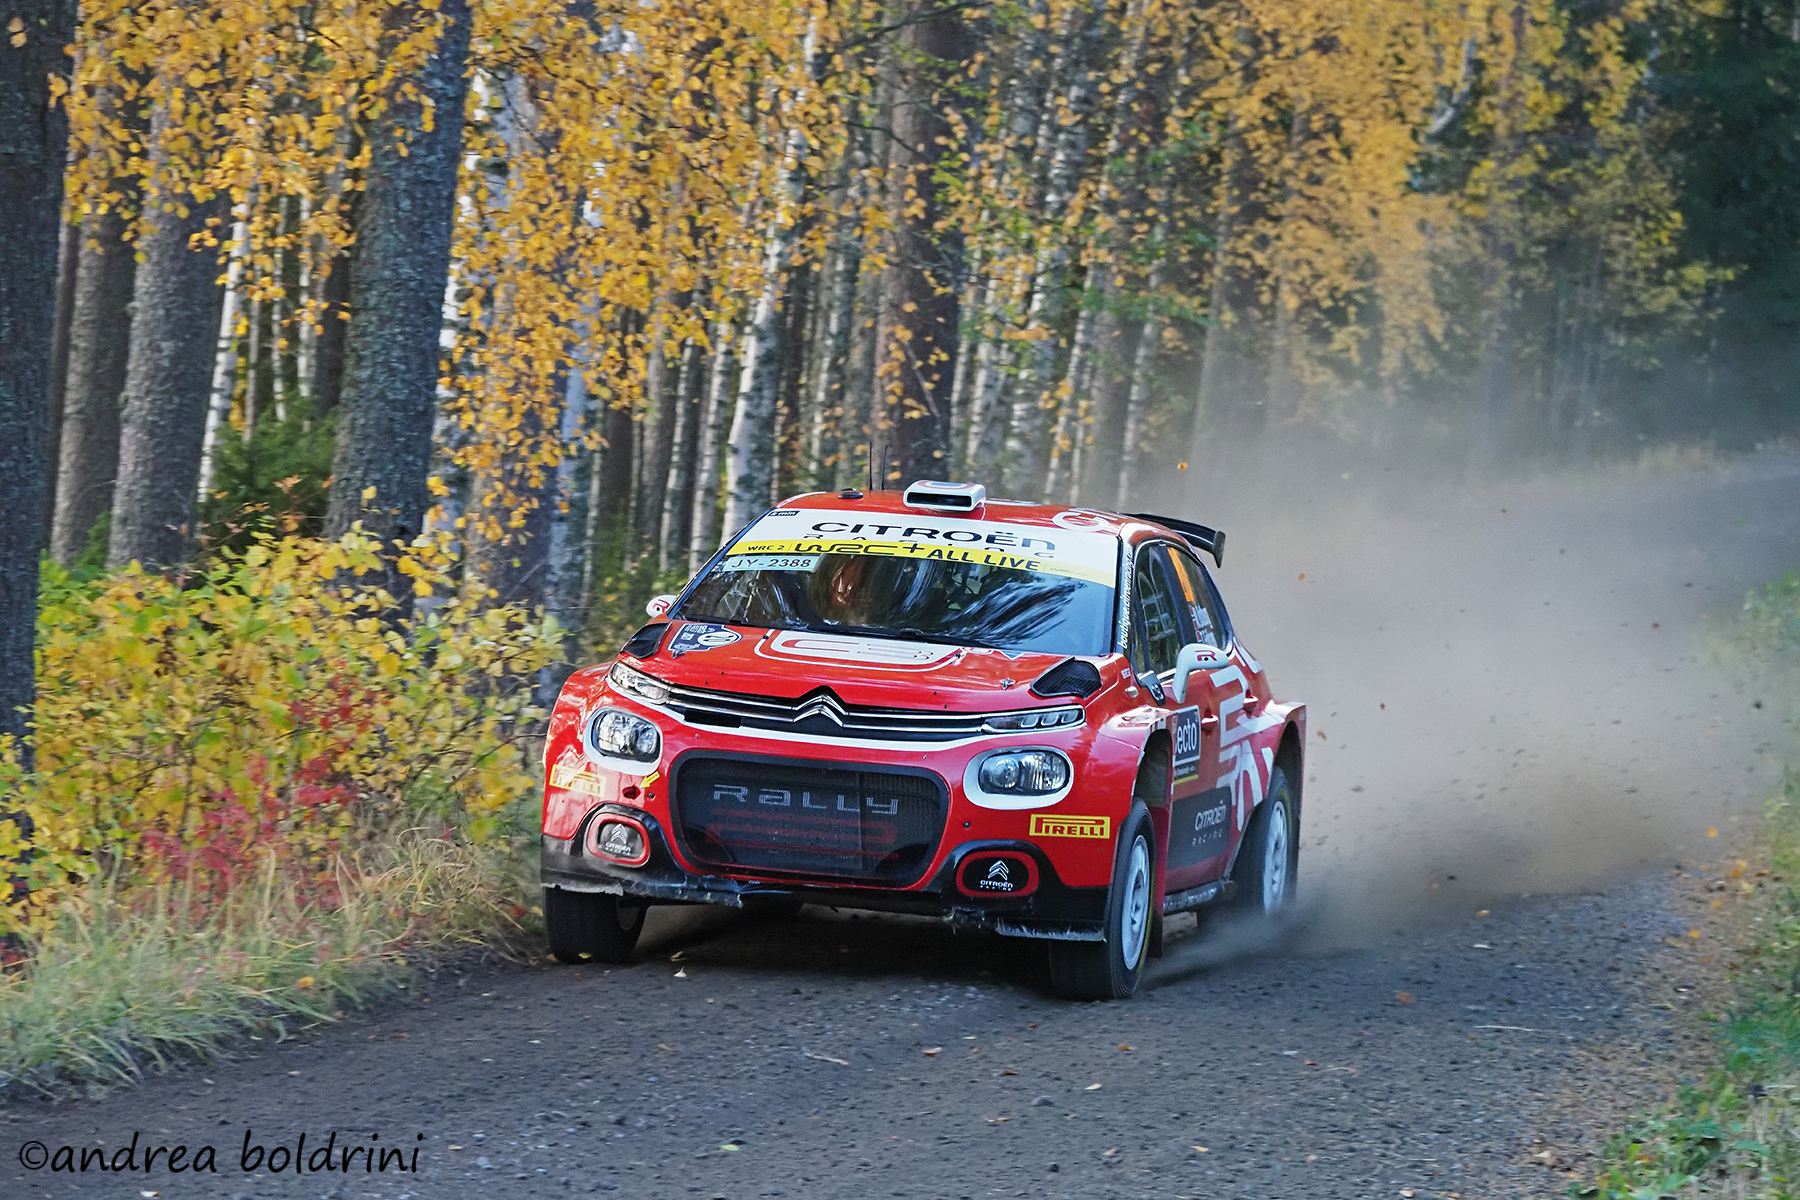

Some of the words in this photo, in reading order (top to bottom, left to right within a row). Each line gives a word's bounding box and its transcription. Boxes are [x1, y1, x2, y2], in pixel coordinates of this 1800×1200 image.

[927, 549, 975, 563] ALL
[984, 554, 1041, 571] LIVE
[1175, 718, 1198, 754] ecto
[1034, 817, 1105, 836] PIRELLI
